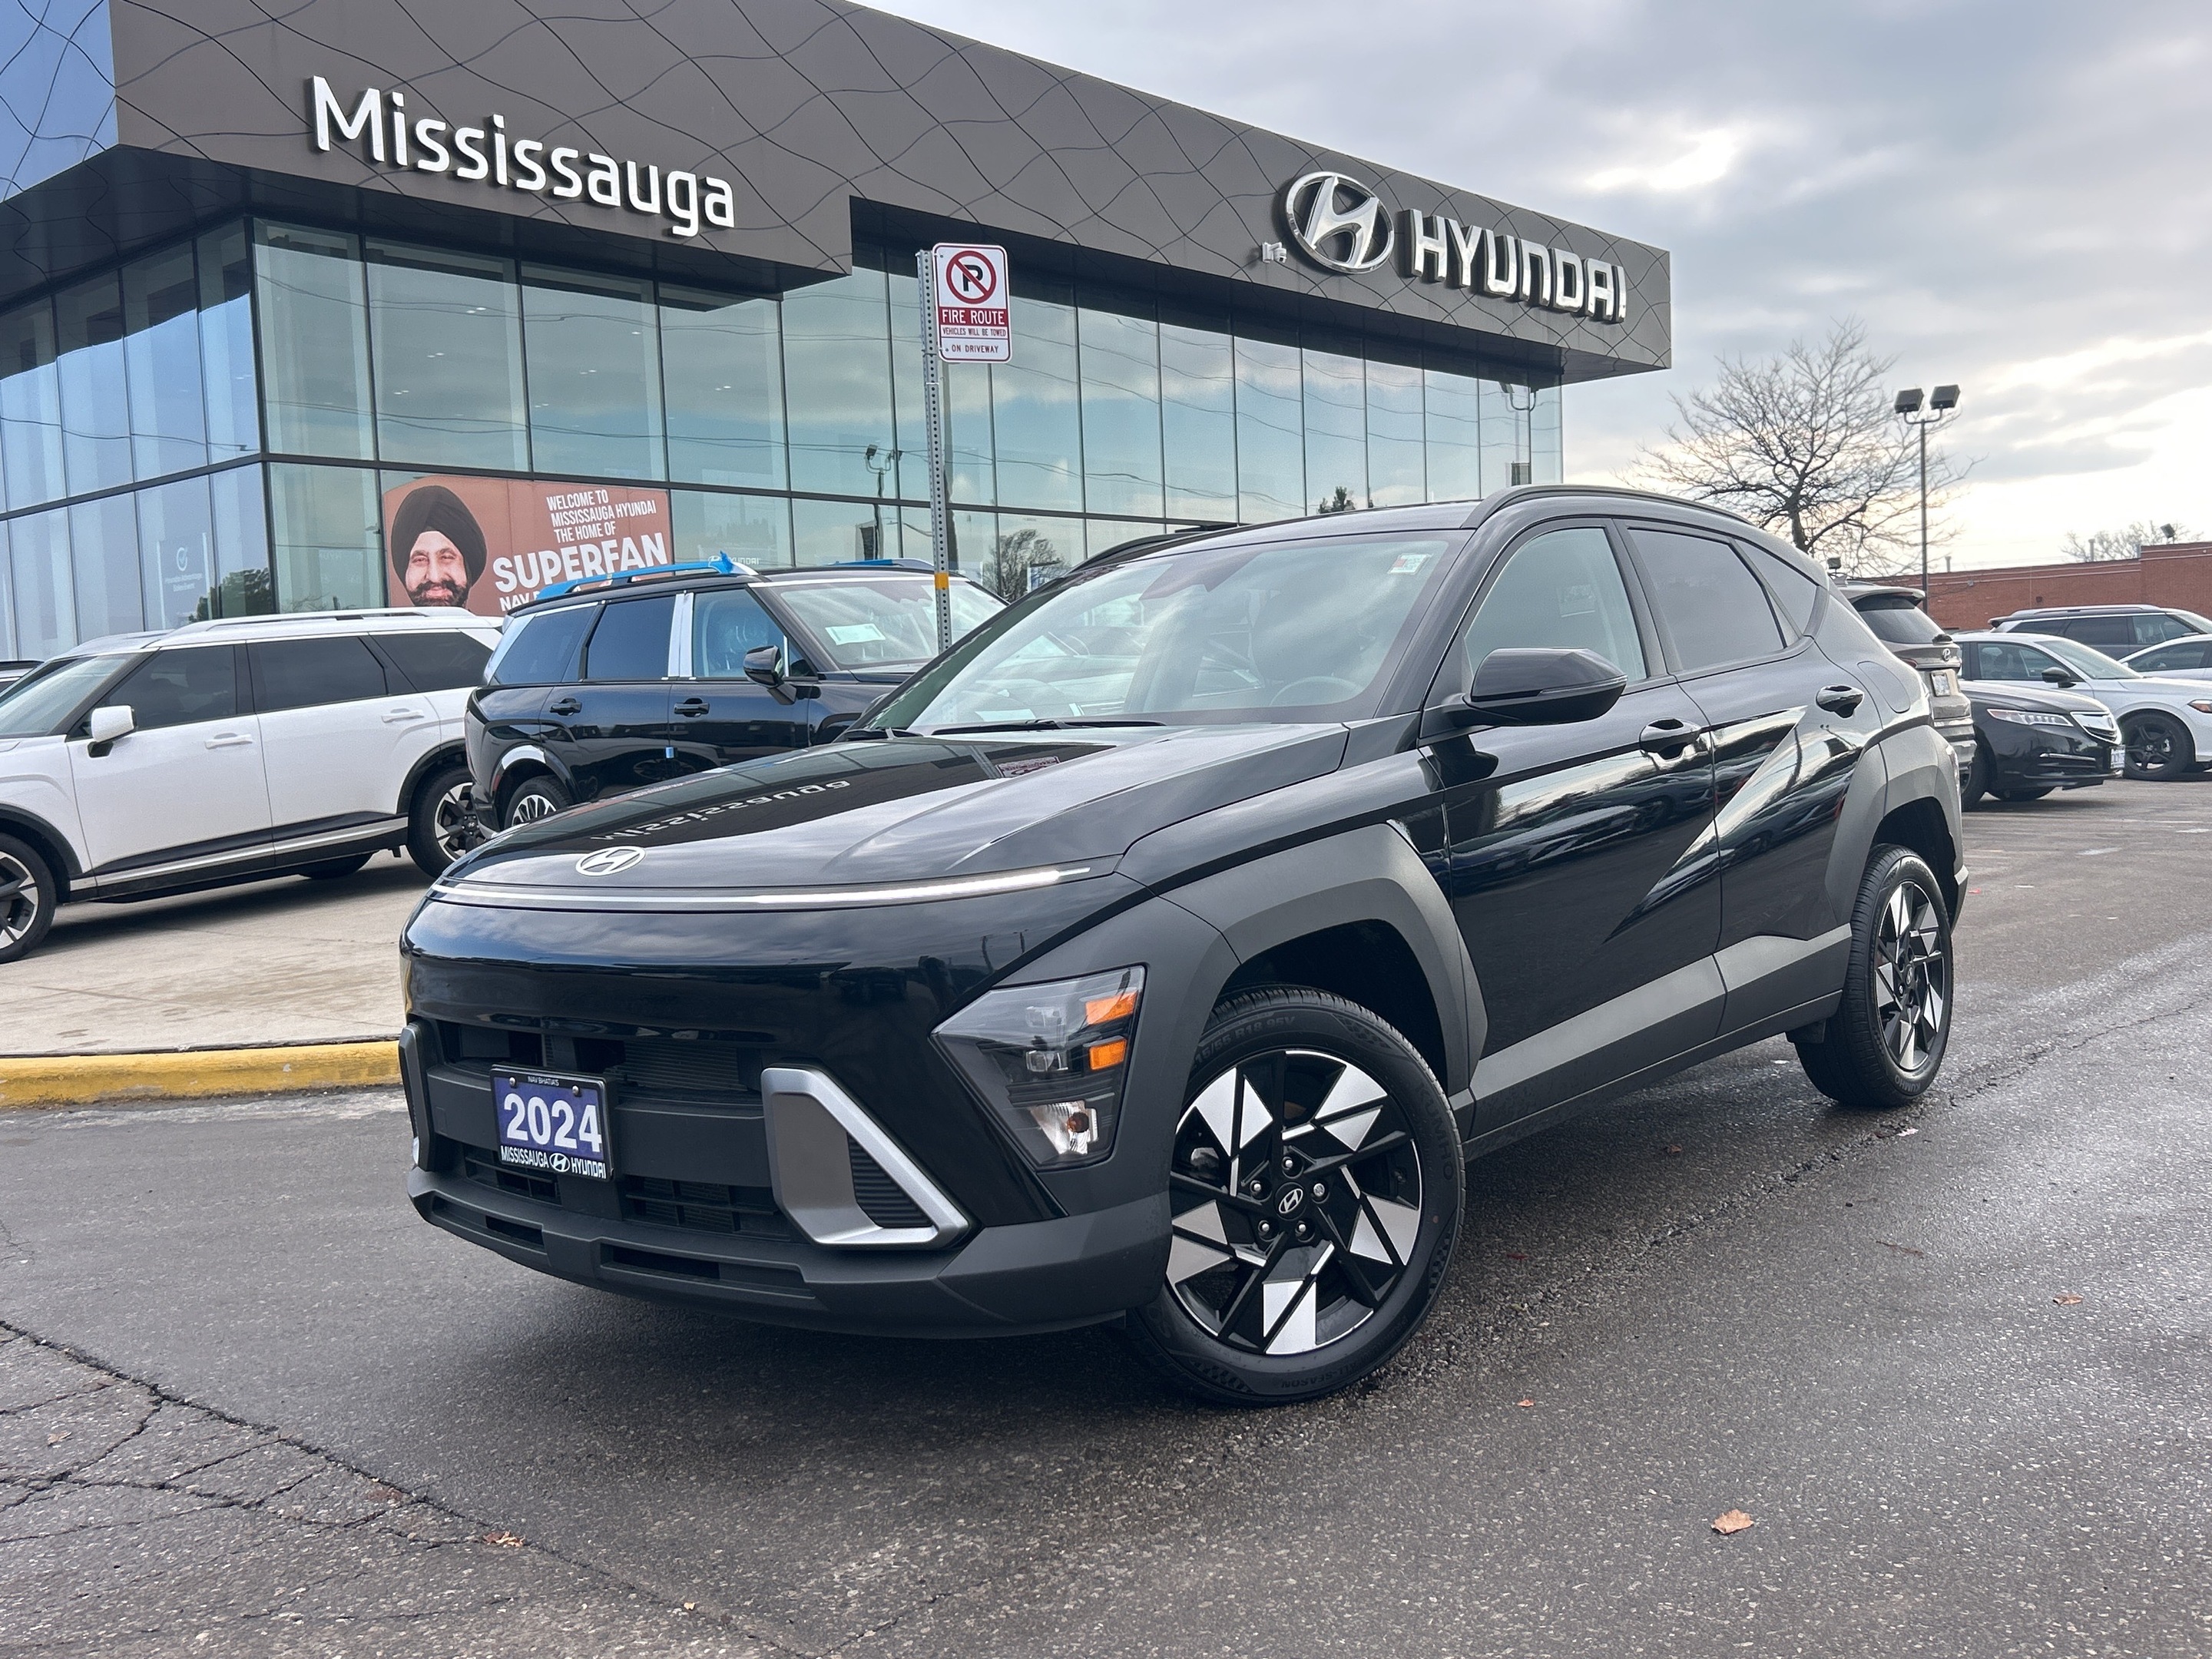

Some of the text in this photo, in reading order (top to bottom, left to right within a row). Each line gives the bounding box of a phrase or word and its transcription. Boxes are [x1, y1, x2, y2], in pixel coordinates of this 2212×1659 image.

[312, 75, 735, 237] Mississauga
[1405, 208, 1628, 323] HYUNDAI
[942, 309, 1005, 325] FIRE ROUTE
[942, 326, 966, 336] VEHICLES
[968, 328, 979, 336] WILL
[982, 328, 988, 336] BE
[951, 344, 998, 353] ON DRIVEWAY
[546, 489, 609, 511] WELCOME TO
[550, 500, 657, 528] MISSISSAUGA HYUNDAI
[554, 521, 616, 543] THE HOME OF
[492, 532, 668, 593] SUPERFAN
[499, 593, 530, 611] NAV
[1194, 1035, 1231, 1063] 15/55
[1234, 1022, 1263, 1038] R18
[1894, 1074, 1921, 1092] KUMHO
[504, 1093, 603, 1153] 2024
[500, 1145, 607, 1180] MISSISSAUGA HYUNDAI
